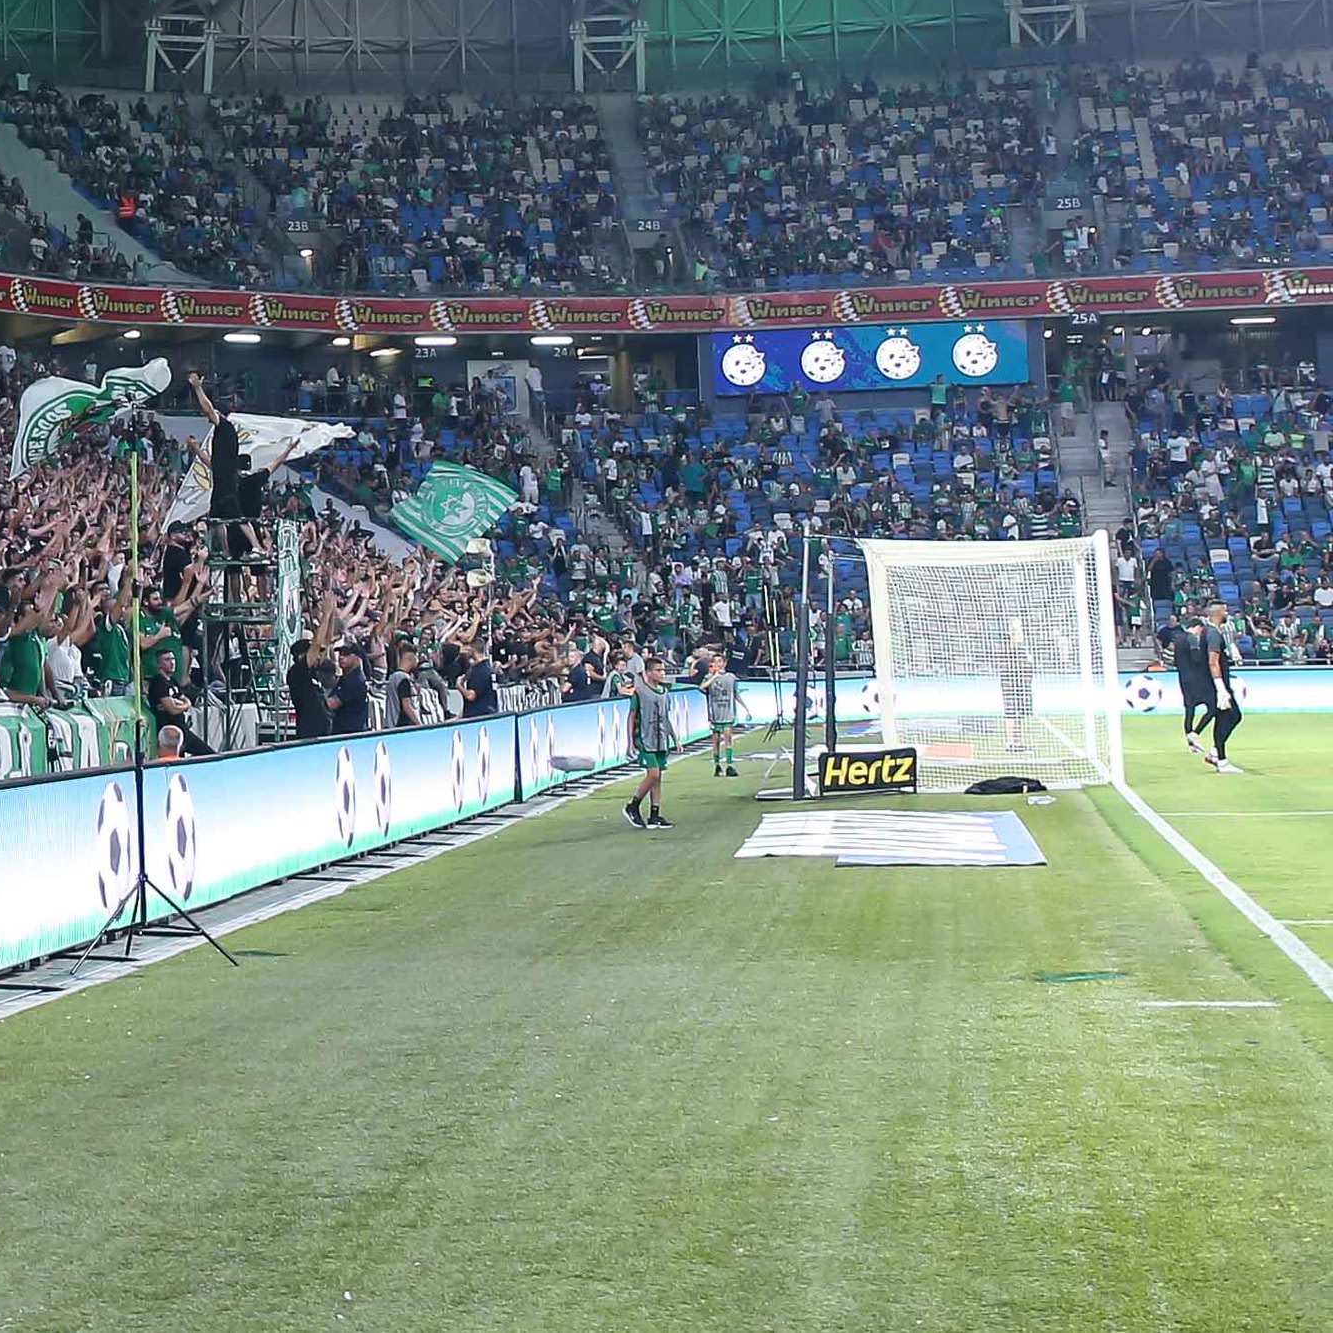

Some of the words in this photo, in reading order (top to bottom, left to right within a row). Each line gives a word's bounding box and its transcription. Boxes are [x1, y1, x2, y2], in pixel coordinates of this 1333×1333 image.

[1056, 197, 1081, 210] 25B
[288, 220, 309, 232] 23B
[637, 220, 661, 231] 24B
[1285, 276, 1333, 297] Win
[1071, 313, 1098, 325] 25A
[824, 754, 914, 786] Hertz
